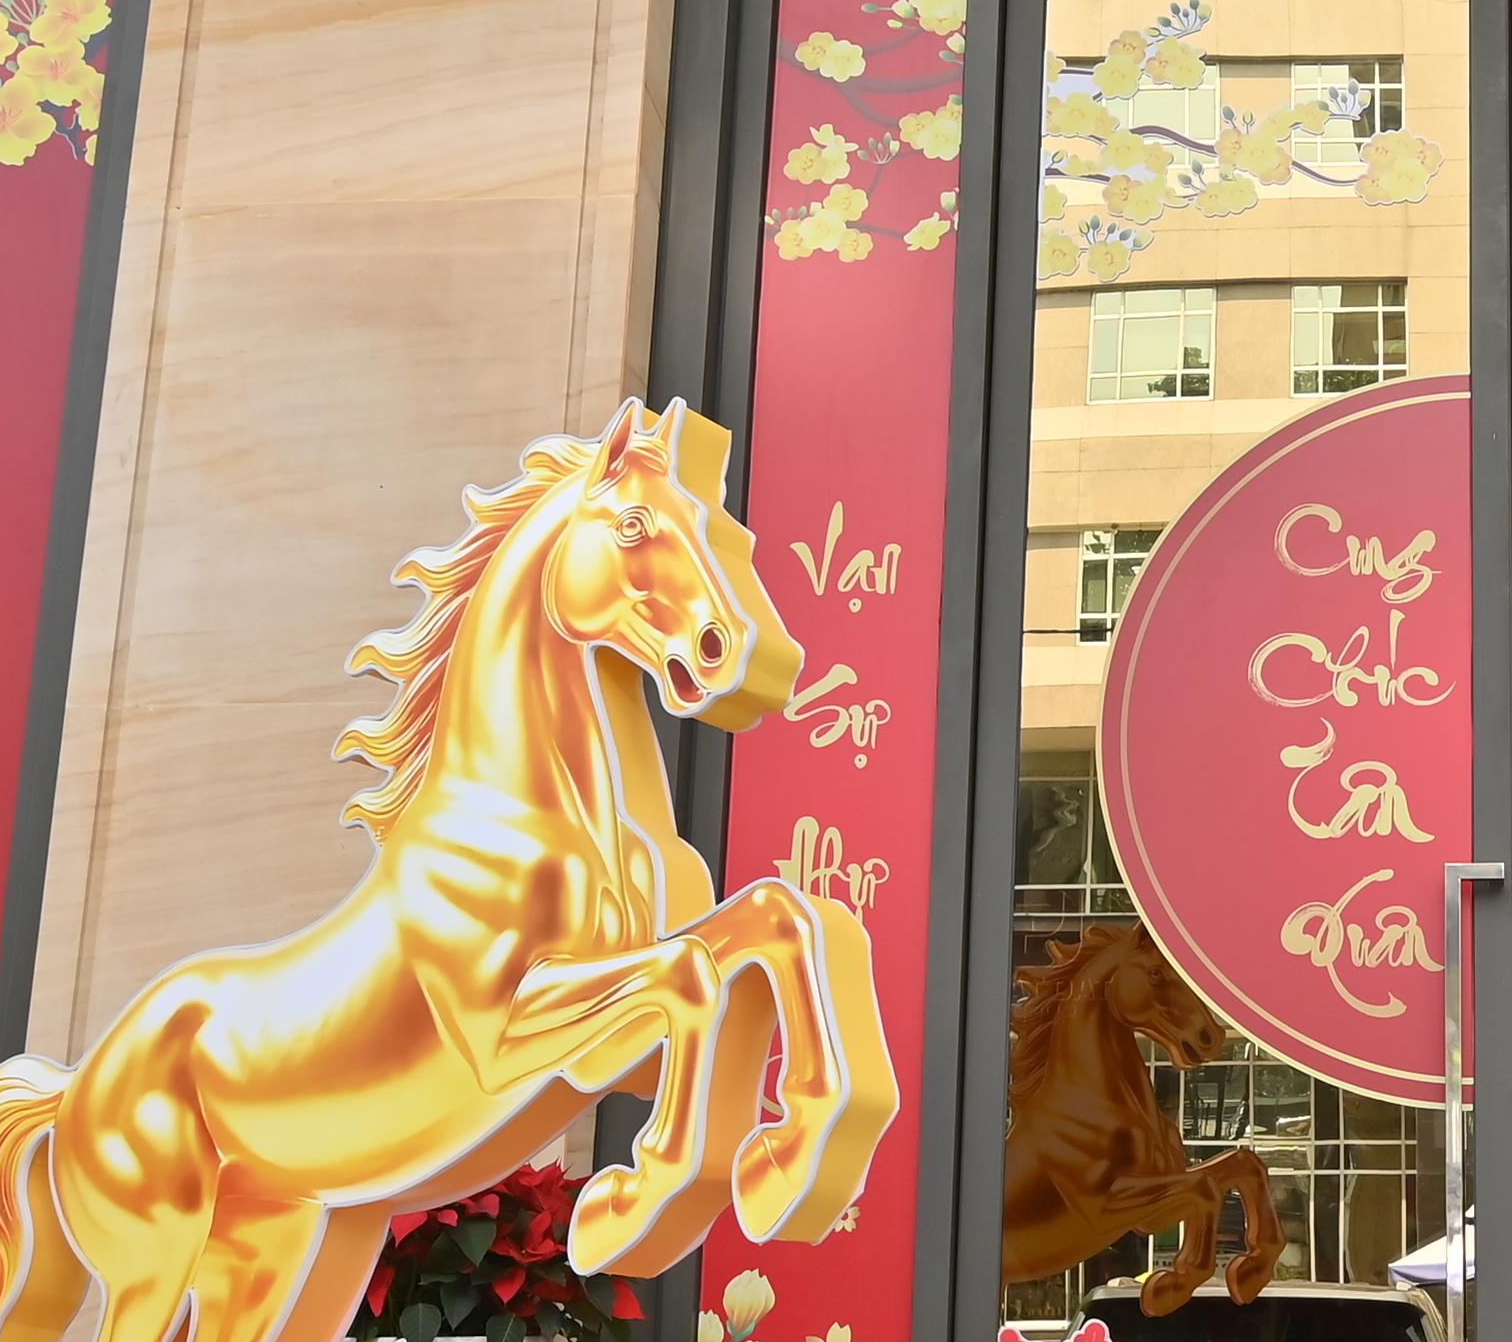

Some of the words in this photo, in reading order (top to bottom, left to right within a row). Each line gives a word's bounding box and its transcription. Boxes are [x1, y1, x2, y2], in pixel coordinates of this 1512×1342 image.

[789, 501, 901, 613] Vạn
[1274, 503, 1442, 603] Cung
[1247, 609, 1456, 708] Chúc
